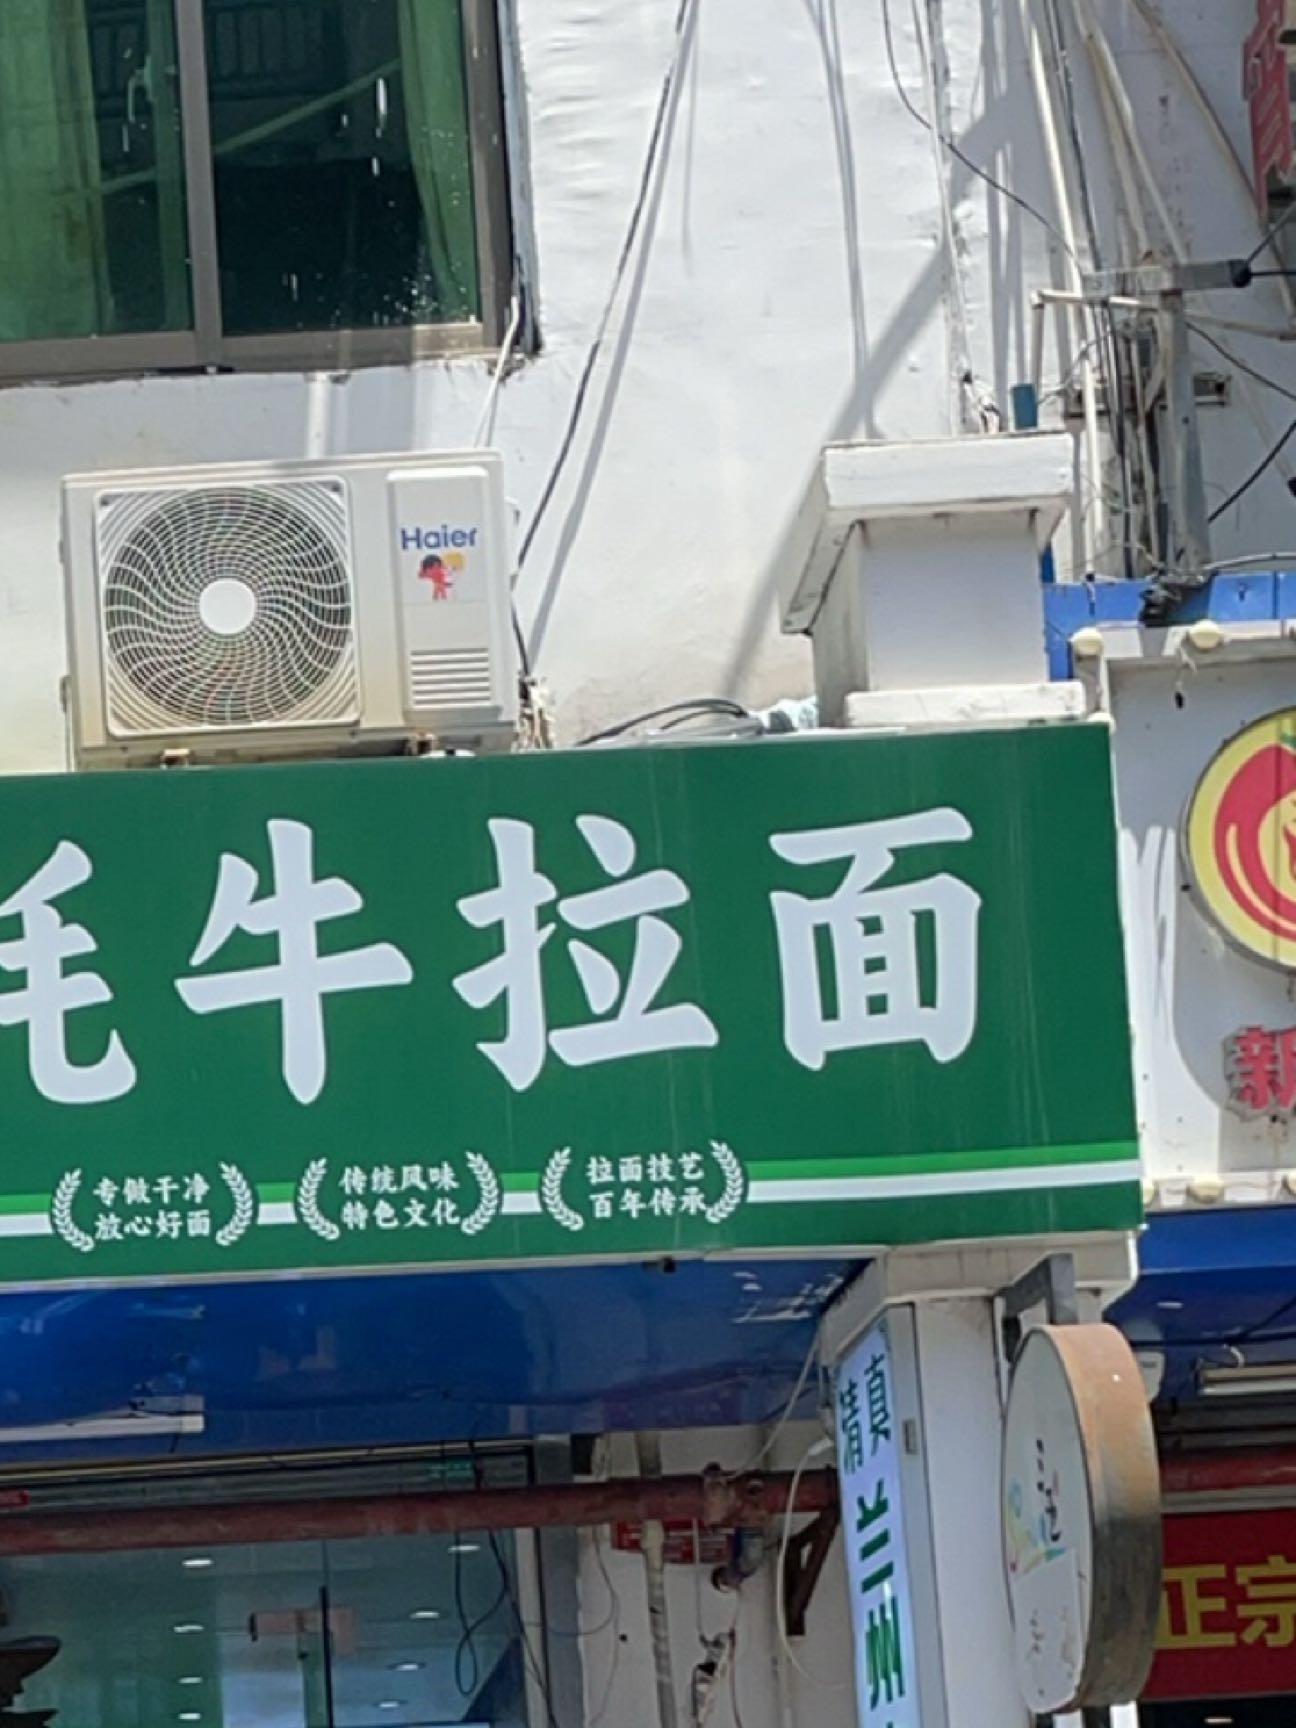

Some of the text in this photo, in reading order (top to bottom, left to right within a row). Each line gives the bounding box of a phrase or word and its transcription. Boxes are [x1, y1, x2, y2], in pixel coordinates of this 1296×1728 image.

[401, 524, 478, 551] Haier
[338, 1162, 461, 1196] 传统风味
[586, 1152, 705, 1186] 拉面技艺
[93, 1174, 211, 1206] 专做干净
[589, 1186, 707, 1220] 百年传承
[94, 1208, 212, 1242] 放心好面
[341, 1197, 461, 1231] 特色文化
[1154, 1554, 1296, 1650] 正宗
